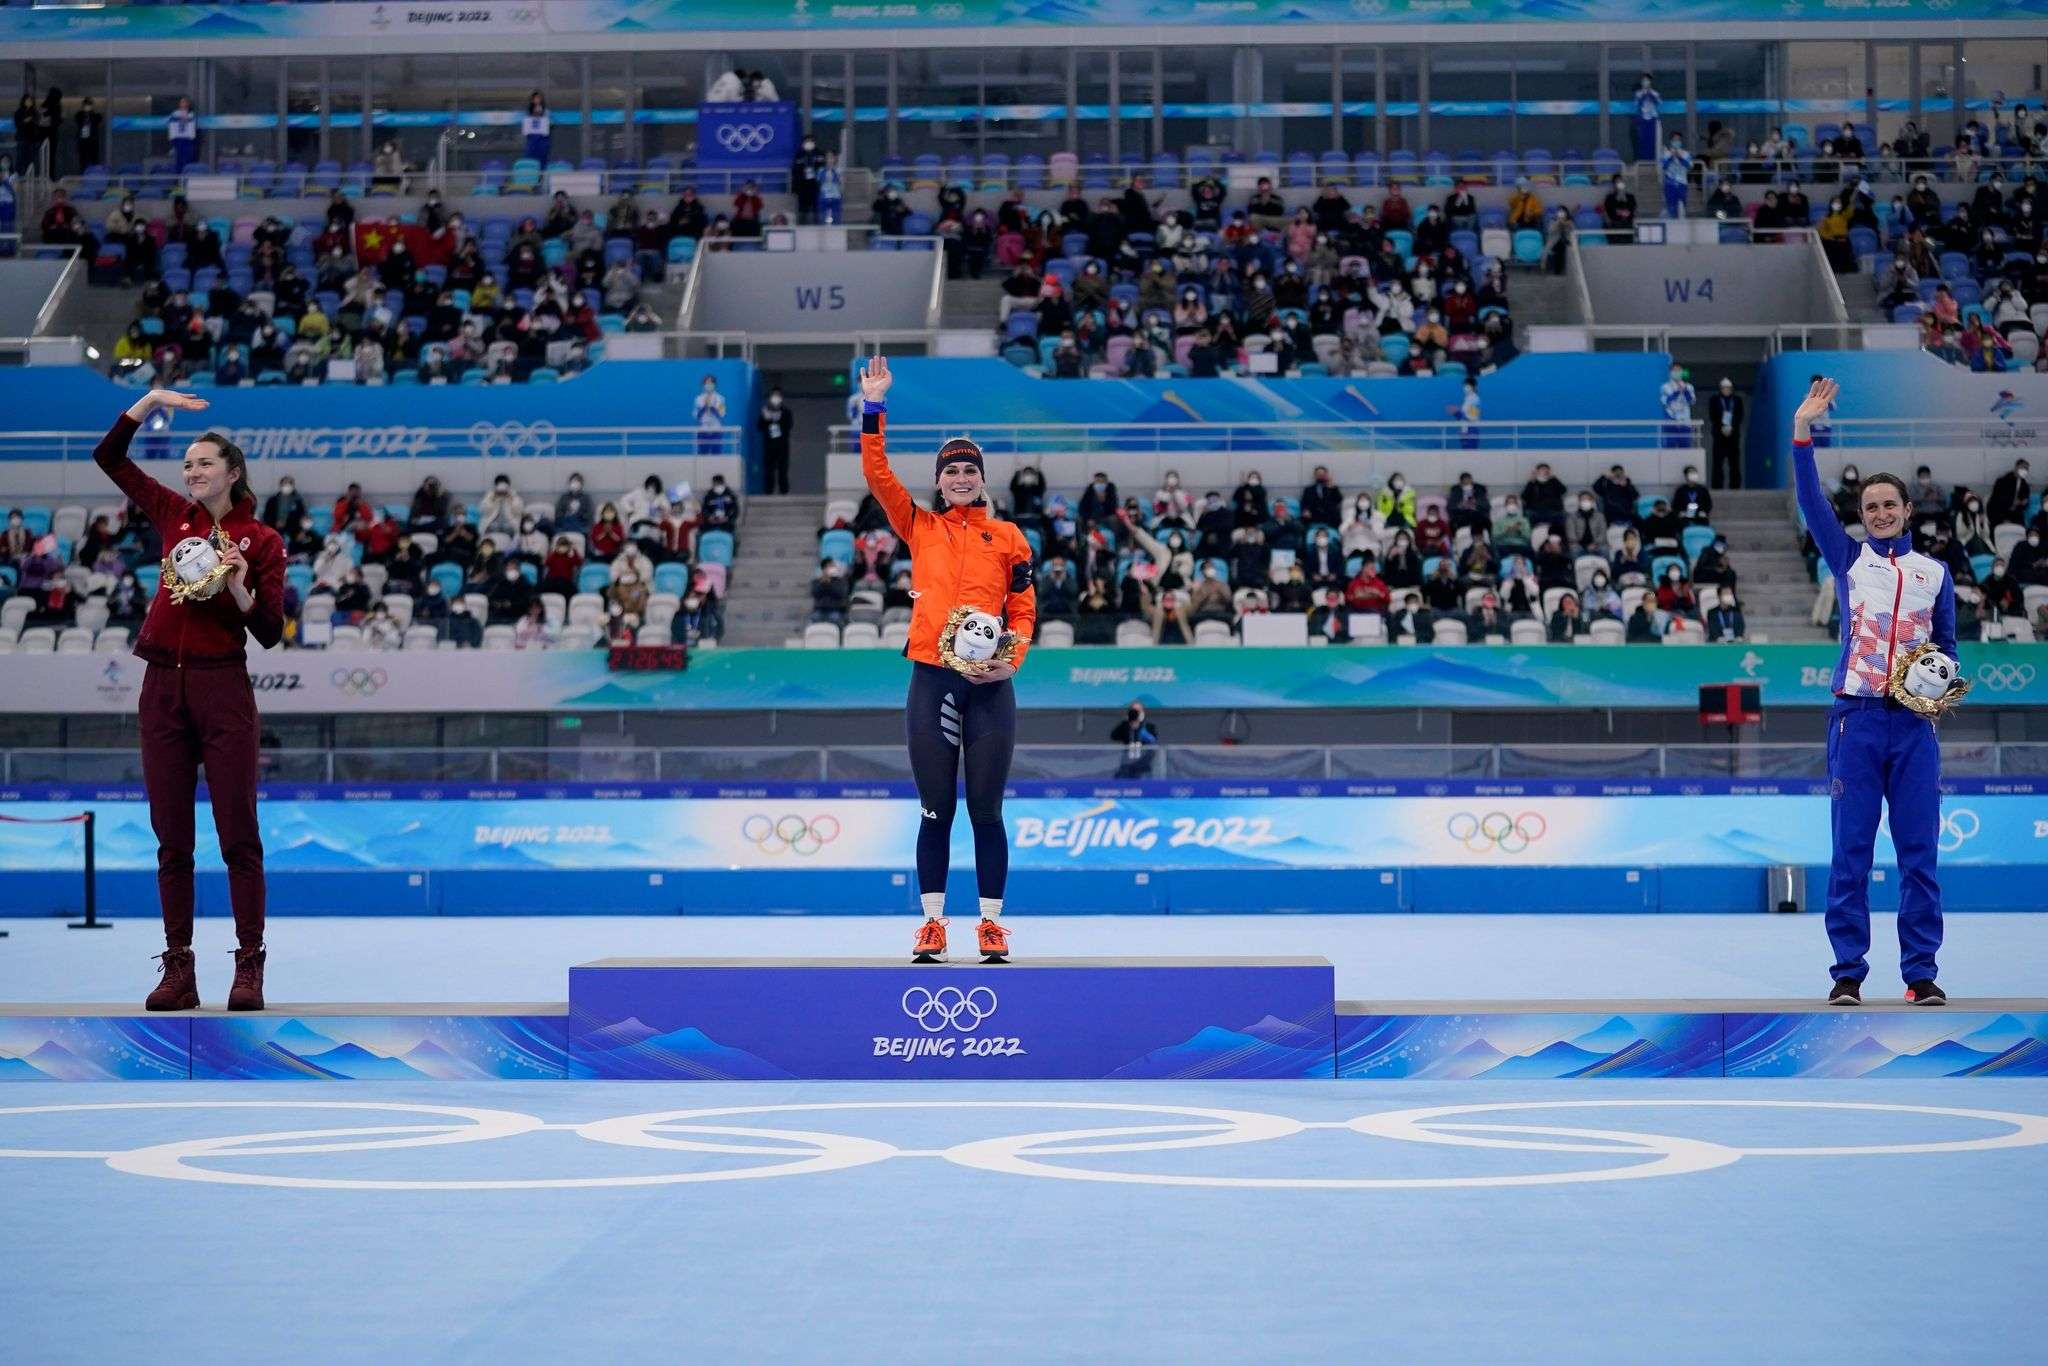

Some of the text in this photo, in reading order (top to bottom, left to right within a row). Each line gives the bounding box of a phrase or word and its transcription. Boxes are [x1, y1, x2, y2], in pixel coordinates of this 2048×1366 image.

[457, 11, 493, 22] 2022
[796, 285, 846, 311] W5
[1664, 278, 1714, 303] W4
[342, 425, 438, 457] 2022
[250, 673, 304, 691] 2022
[1133, 666, 1177, 682] 2022
[473, 825, 615, 848] BEIJING 2022
[1014, 816, 1283, 857] BEIJING 2022
[872, 1036, 1029, 1063] BEIJING 2022
